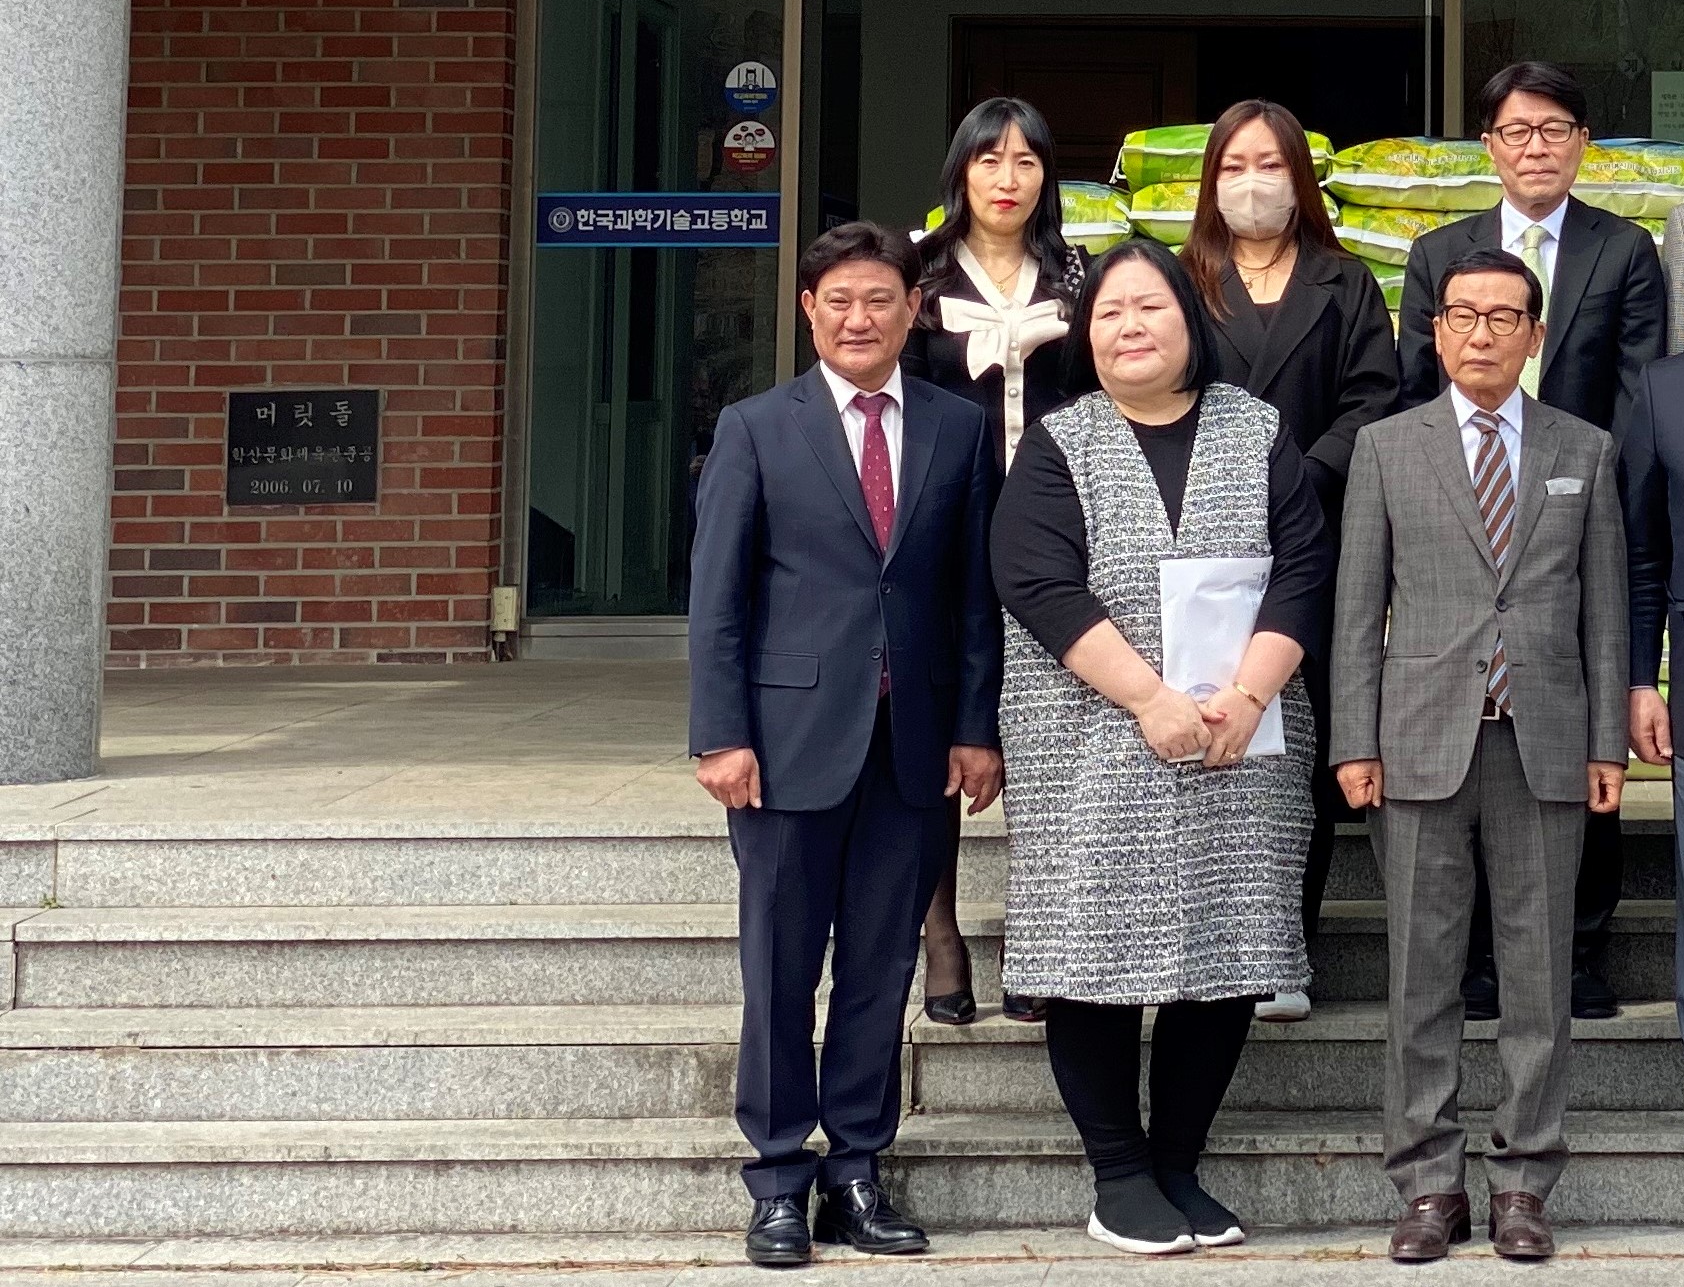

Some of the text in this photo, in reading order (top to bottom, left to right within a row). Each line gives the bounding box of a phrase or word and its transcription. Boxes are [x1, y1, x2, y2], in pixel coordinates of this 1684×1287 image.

[576, 208, 769, 232] 한국과학기술고등학교
[250, 479, 294, 495] 2006.
[336, 479, 354, 494] 10
